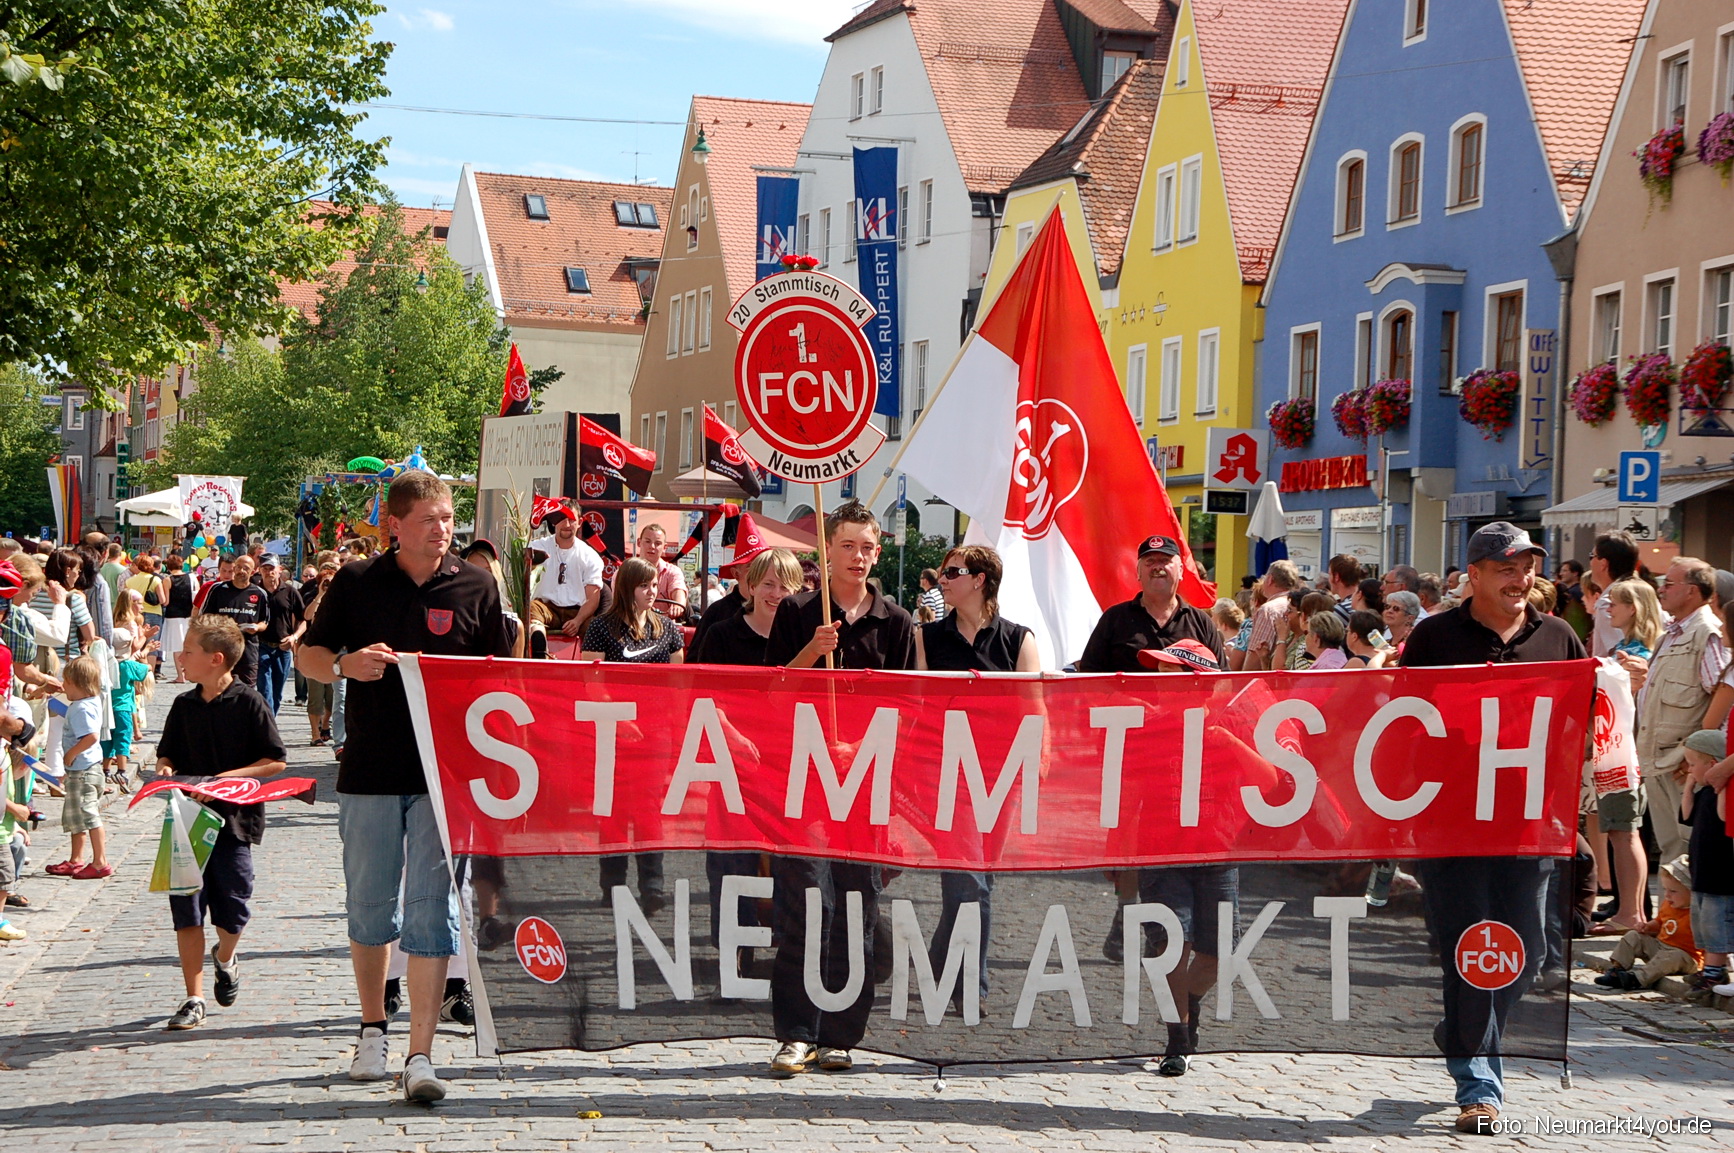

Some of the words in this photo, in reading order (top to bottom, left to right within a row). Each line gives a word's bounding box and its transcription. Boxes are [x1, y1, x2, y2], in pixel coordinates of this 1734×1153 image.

[732, 303, 751, 326] 20
[754, 276, 841, 303] Stammtisch
[848, 299, 867, 321] 04
[875, 248, 893, 343] RUPPERT
[788, 321, 818, 364] 1.
[879, 346, 894, 384] K&L
[758, 369, 856, 415] FCN
[1529, 356, 1551, 458] WITTL
[767, 448, 862, 480] Neumarkt
[1278, 455, 1367, 492] APOTHEKE
[1627, 457, 1652, 497] P
[583, 481, 604, 491] FCN
[464, 690, 1554, 834] STAMMTISCH
[529, 921, 544, 944] 1.
[610, 874, 1368, 1028] NEUMARKT
[1479, 926, 1499, 948] 1.
[521, 944, 565, 967] FCN
[1461, 950, 1519, 974] FCN
